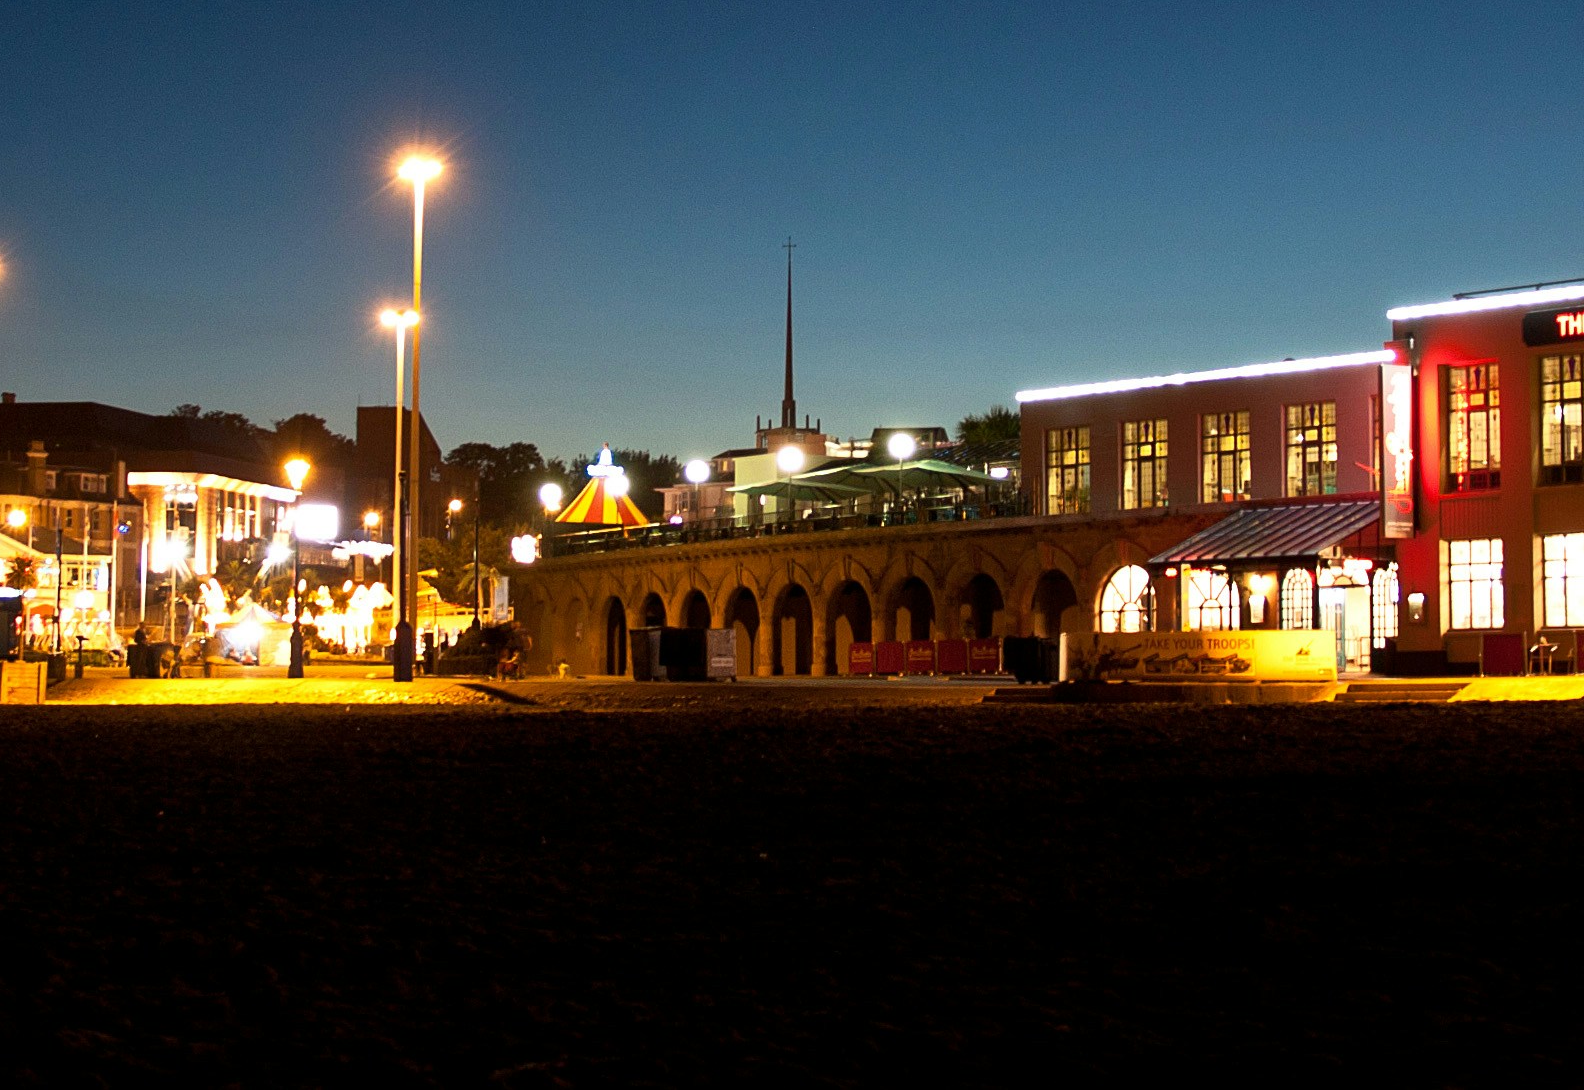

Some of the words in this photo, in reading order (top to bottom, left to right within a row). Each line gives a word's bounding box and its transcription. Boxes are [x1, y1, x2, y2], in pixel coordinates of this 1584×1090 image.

[1145, 638, 1170, 650] TAKE
[1173, 638, 1204, 650] YOUR
[1207, 638, 1255, 650] TROOPS!
